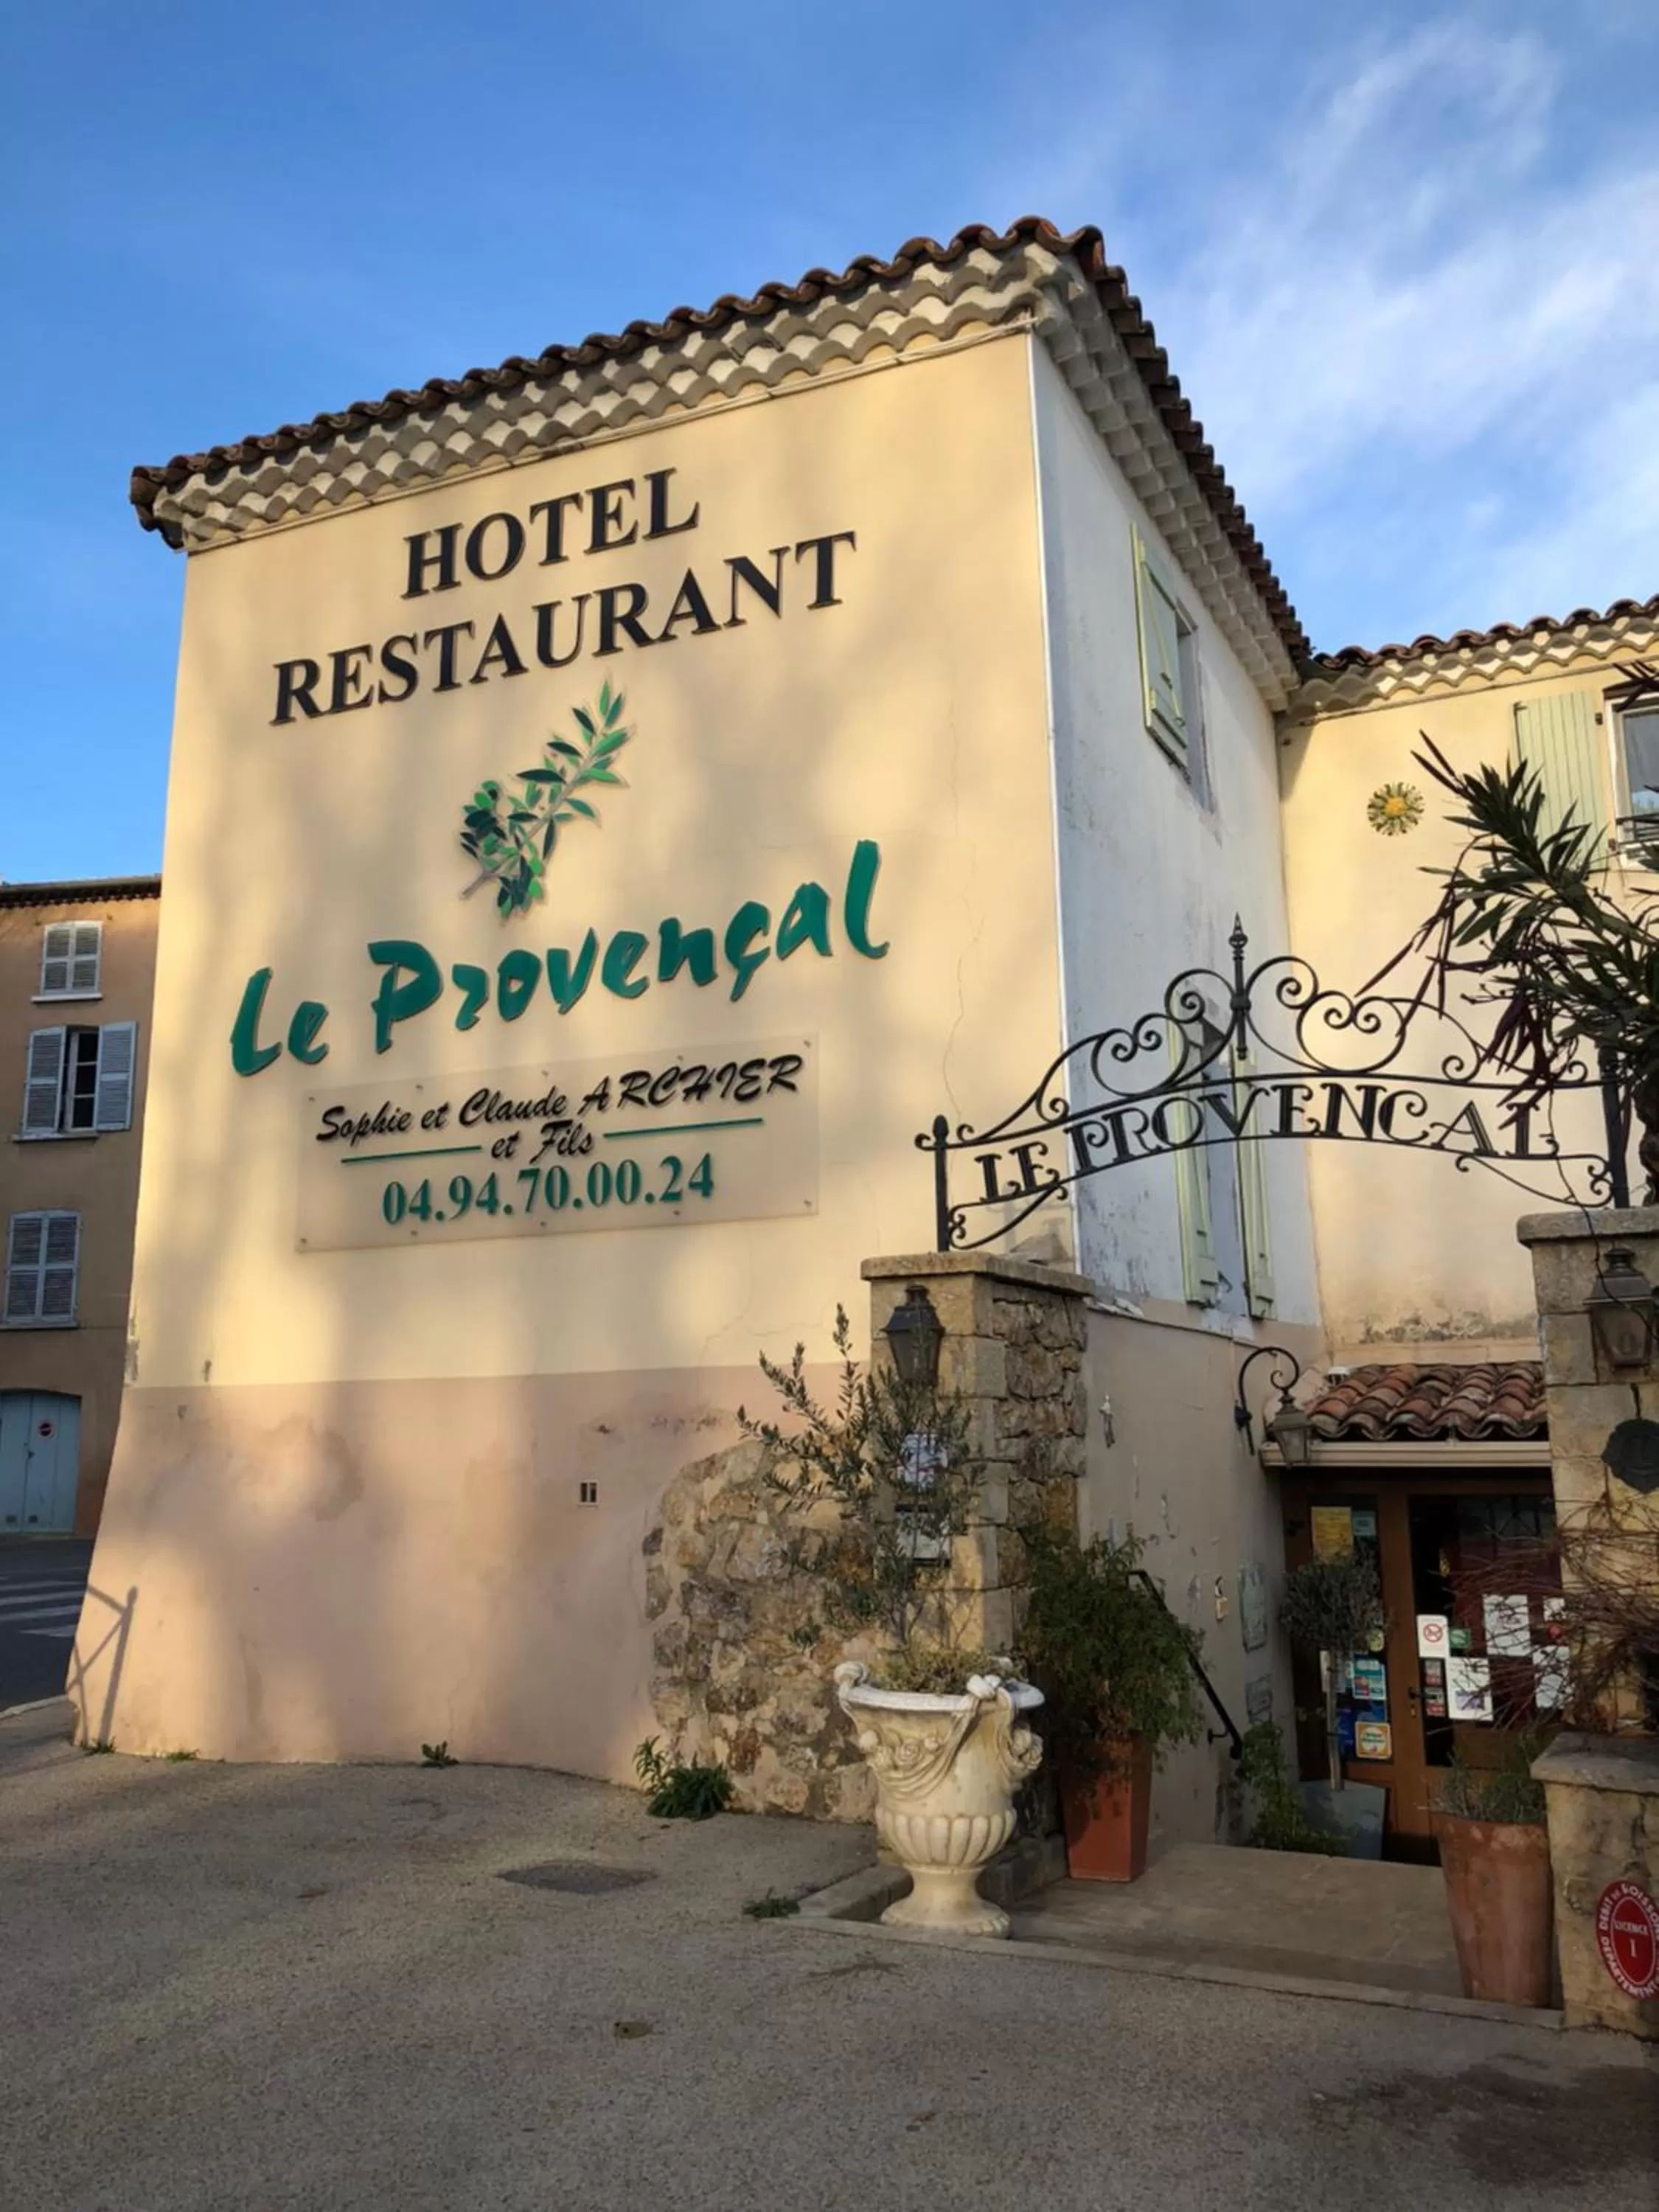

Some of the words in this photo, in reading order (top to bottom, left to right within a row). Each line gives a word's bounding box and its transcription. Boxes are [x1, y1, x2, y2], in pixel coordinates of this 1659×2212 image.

[401, 467, 700, 599] HOTEL
[269, 531, 857, 726] RESTAURANT
[230, 966, 329, 1076] Le
[368, 839, 890, 1054] Provençal
[316, 1102, 412, 1146] Sophie
[420, 1102, 449, 1129] et
[459, 1085, 568, 1127] Claude
[577, 1054, 804, 1115] ARCHIER
[491, 1130, 521, 1160] et
[529, 1119, 595, 1166] Fils
[382, 1152, 715, 1225] 04.94.70.00.24
[975, 1141, 1060, 1203] LE
